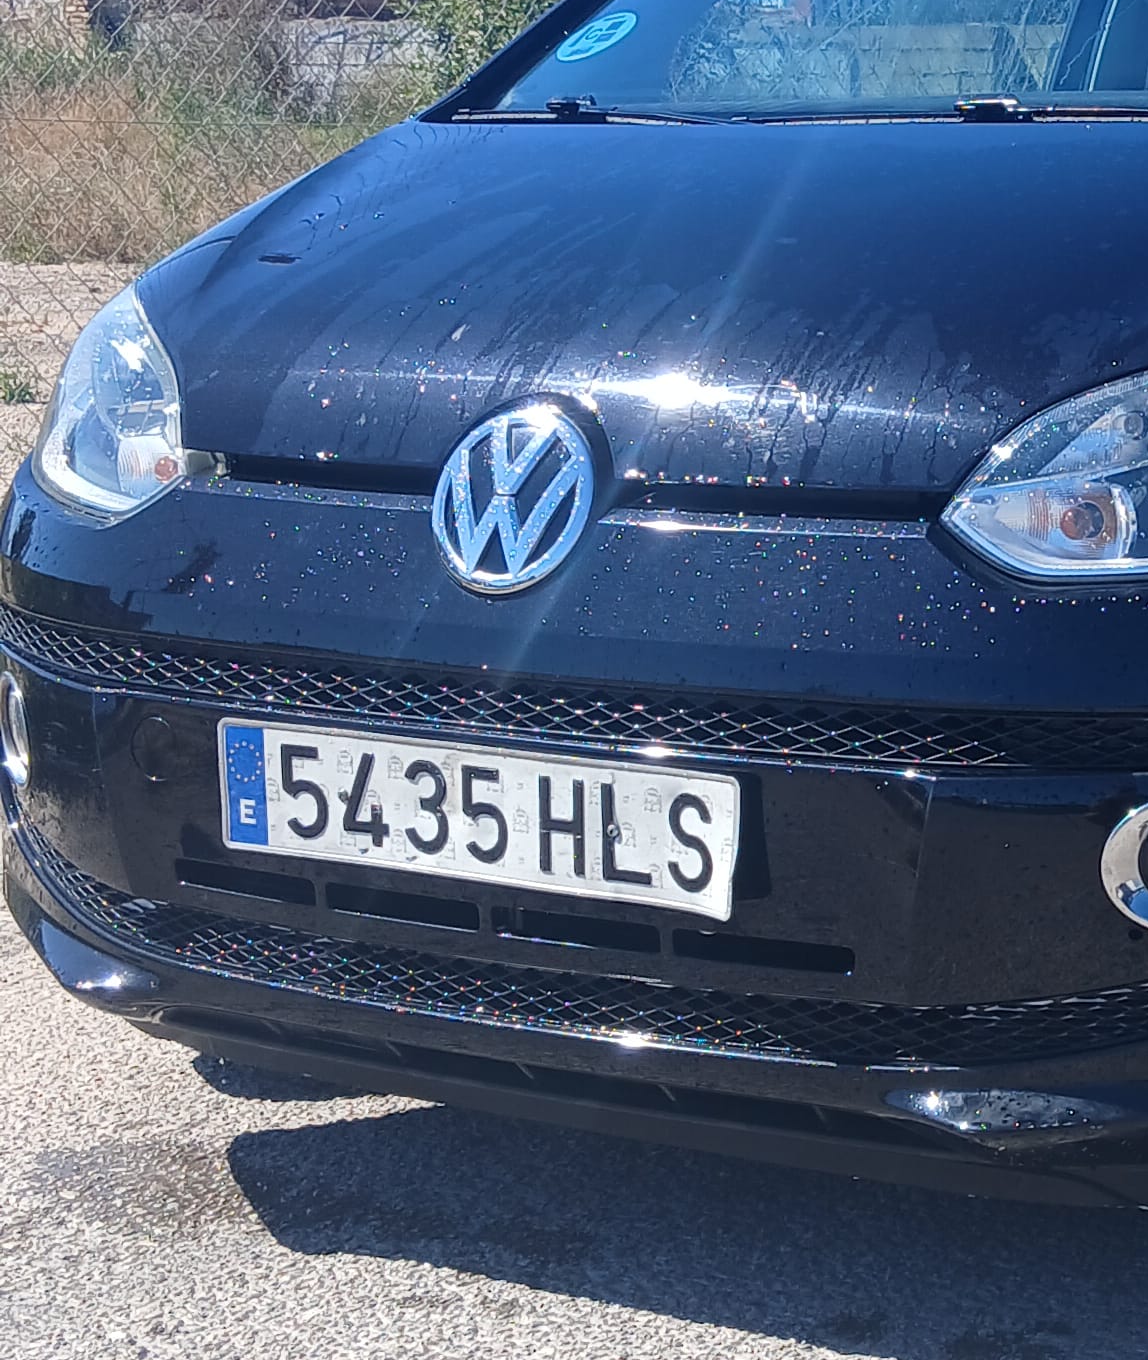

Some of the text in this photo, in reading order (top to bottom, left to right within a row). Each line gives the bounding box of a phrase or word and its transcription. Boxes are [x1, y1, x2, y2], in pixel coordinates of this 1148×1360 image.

[239, 798, 257, 825] E
[279, 742, 715, 894] 5435 HLS
